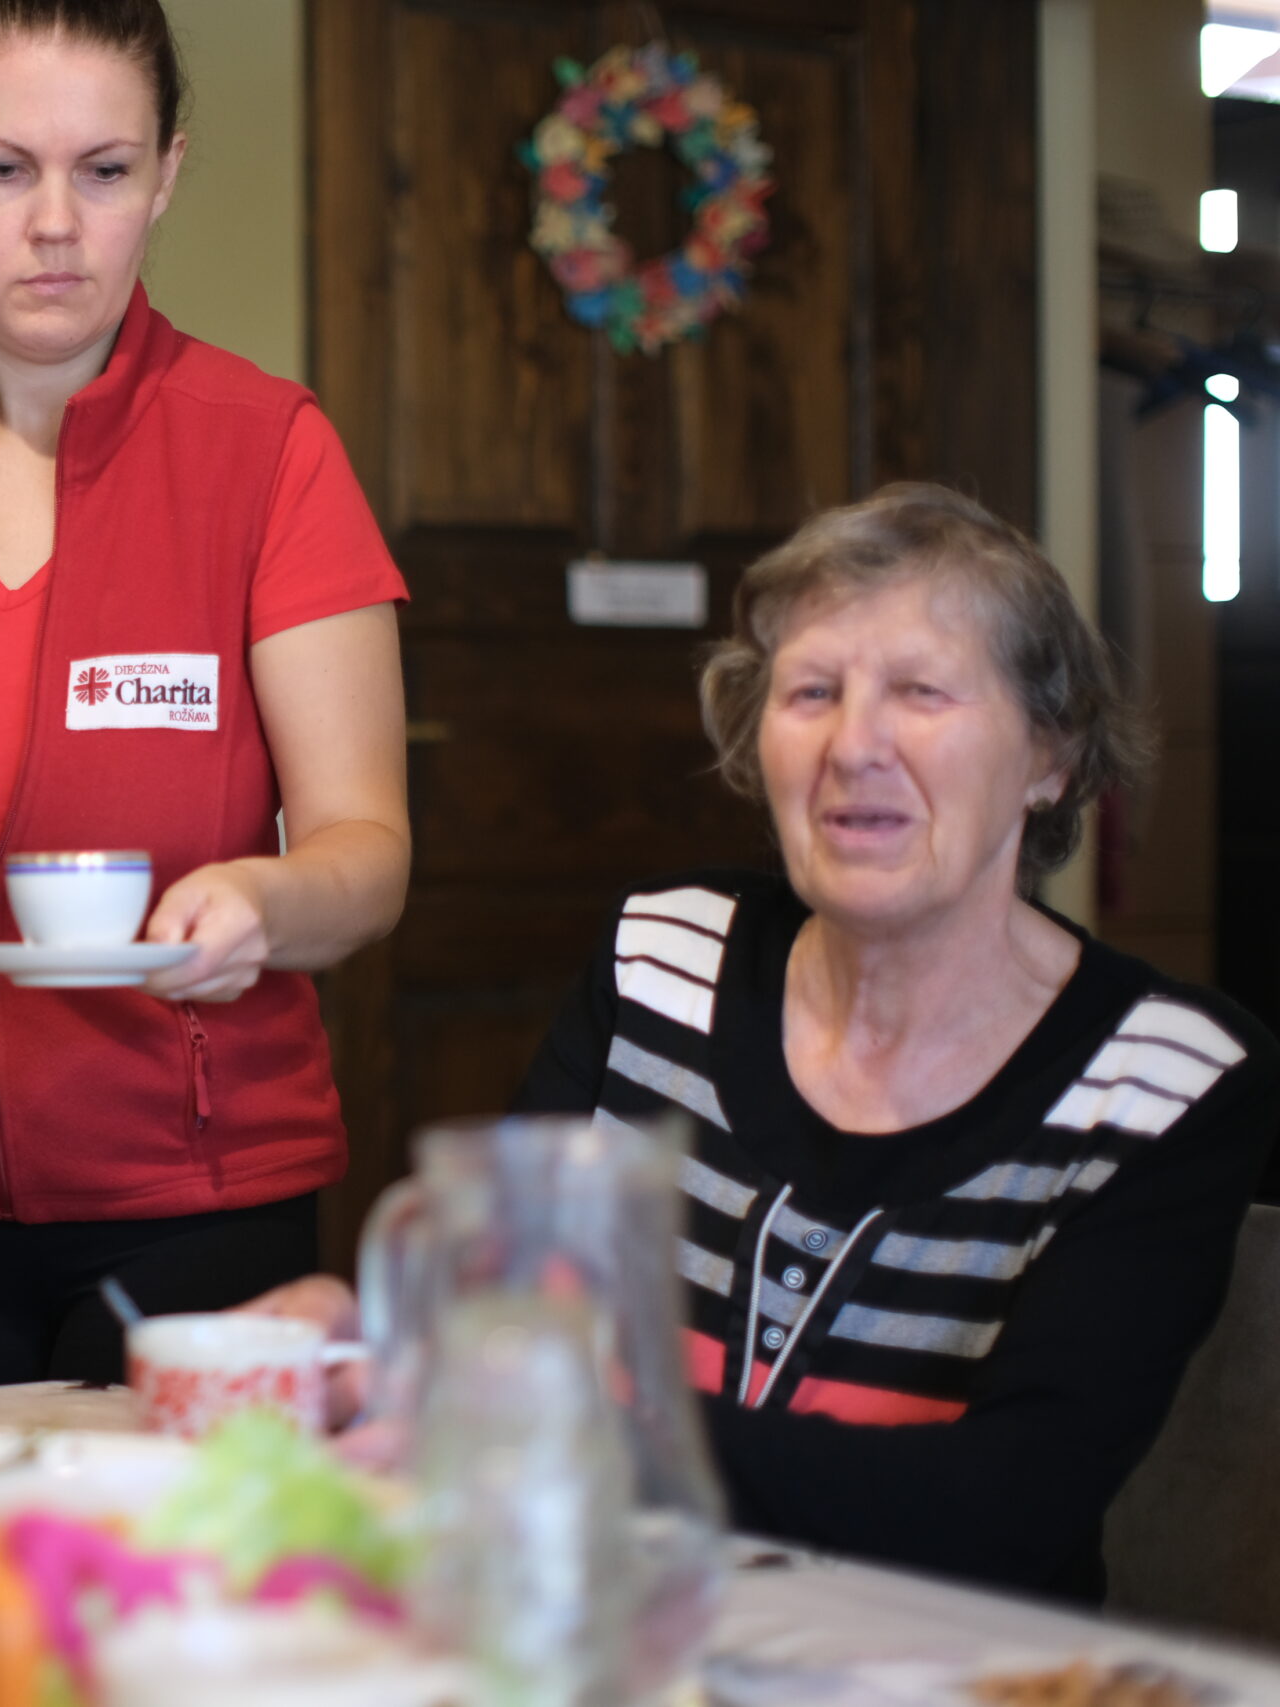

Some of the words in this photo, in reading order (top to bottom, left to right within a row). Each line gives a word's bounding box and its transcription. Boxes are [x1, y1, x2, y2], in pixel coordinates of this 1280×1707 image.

[114, 663, 170, 675] DIECÉZNA
[115, 677, 212, 705] Charita
[169, 708, 211, 722] ROŽŇAVA
